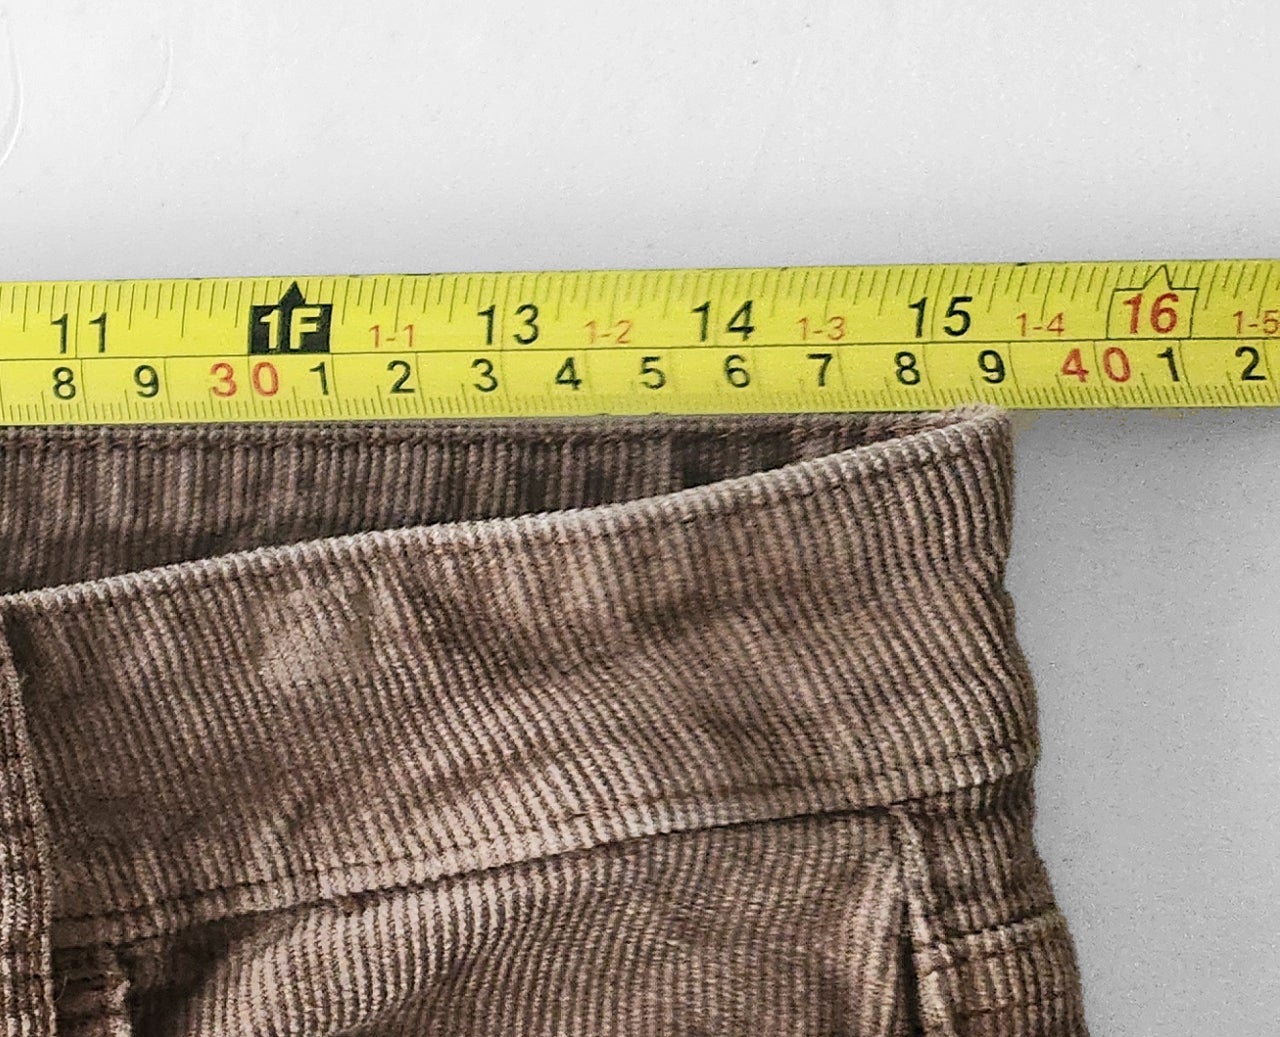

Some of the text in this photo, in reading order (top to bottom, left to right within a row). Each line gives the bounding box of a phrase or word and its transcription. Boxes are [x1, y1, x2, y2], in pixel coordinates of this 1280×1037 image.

[257, 308, 323, 351] 1F
[369, 325, 416, 348] 1-1
[585, 318, 632, 344] 1-2
[798, 315, 846, 341] 1-3
[908, 296, 972, 338] 15
[1017, 311, 1066, 337] 1-4
[1123, 293, 1178, 334] 16
[1233, 309, 1280, 334] 1-5
[52, 367, 76, 400] 8
[134, 365, 159, 397] 9
[309, 362, 329, 395] 1
[386, 360, 415, 393] 2
[472, 358, 498, 392] 3
[554, 356, 582, 390] 4
[640, 355, 666, 389] 5
[724, 353, 751, 388] 6
[807, 353, 833, 387] 7
[894, 351, 921, 386] 8
[978, 349, 1005, 383] 9
[1157, 347, 1180, 382] 1
[1235, 346, 1267, 380] 2
